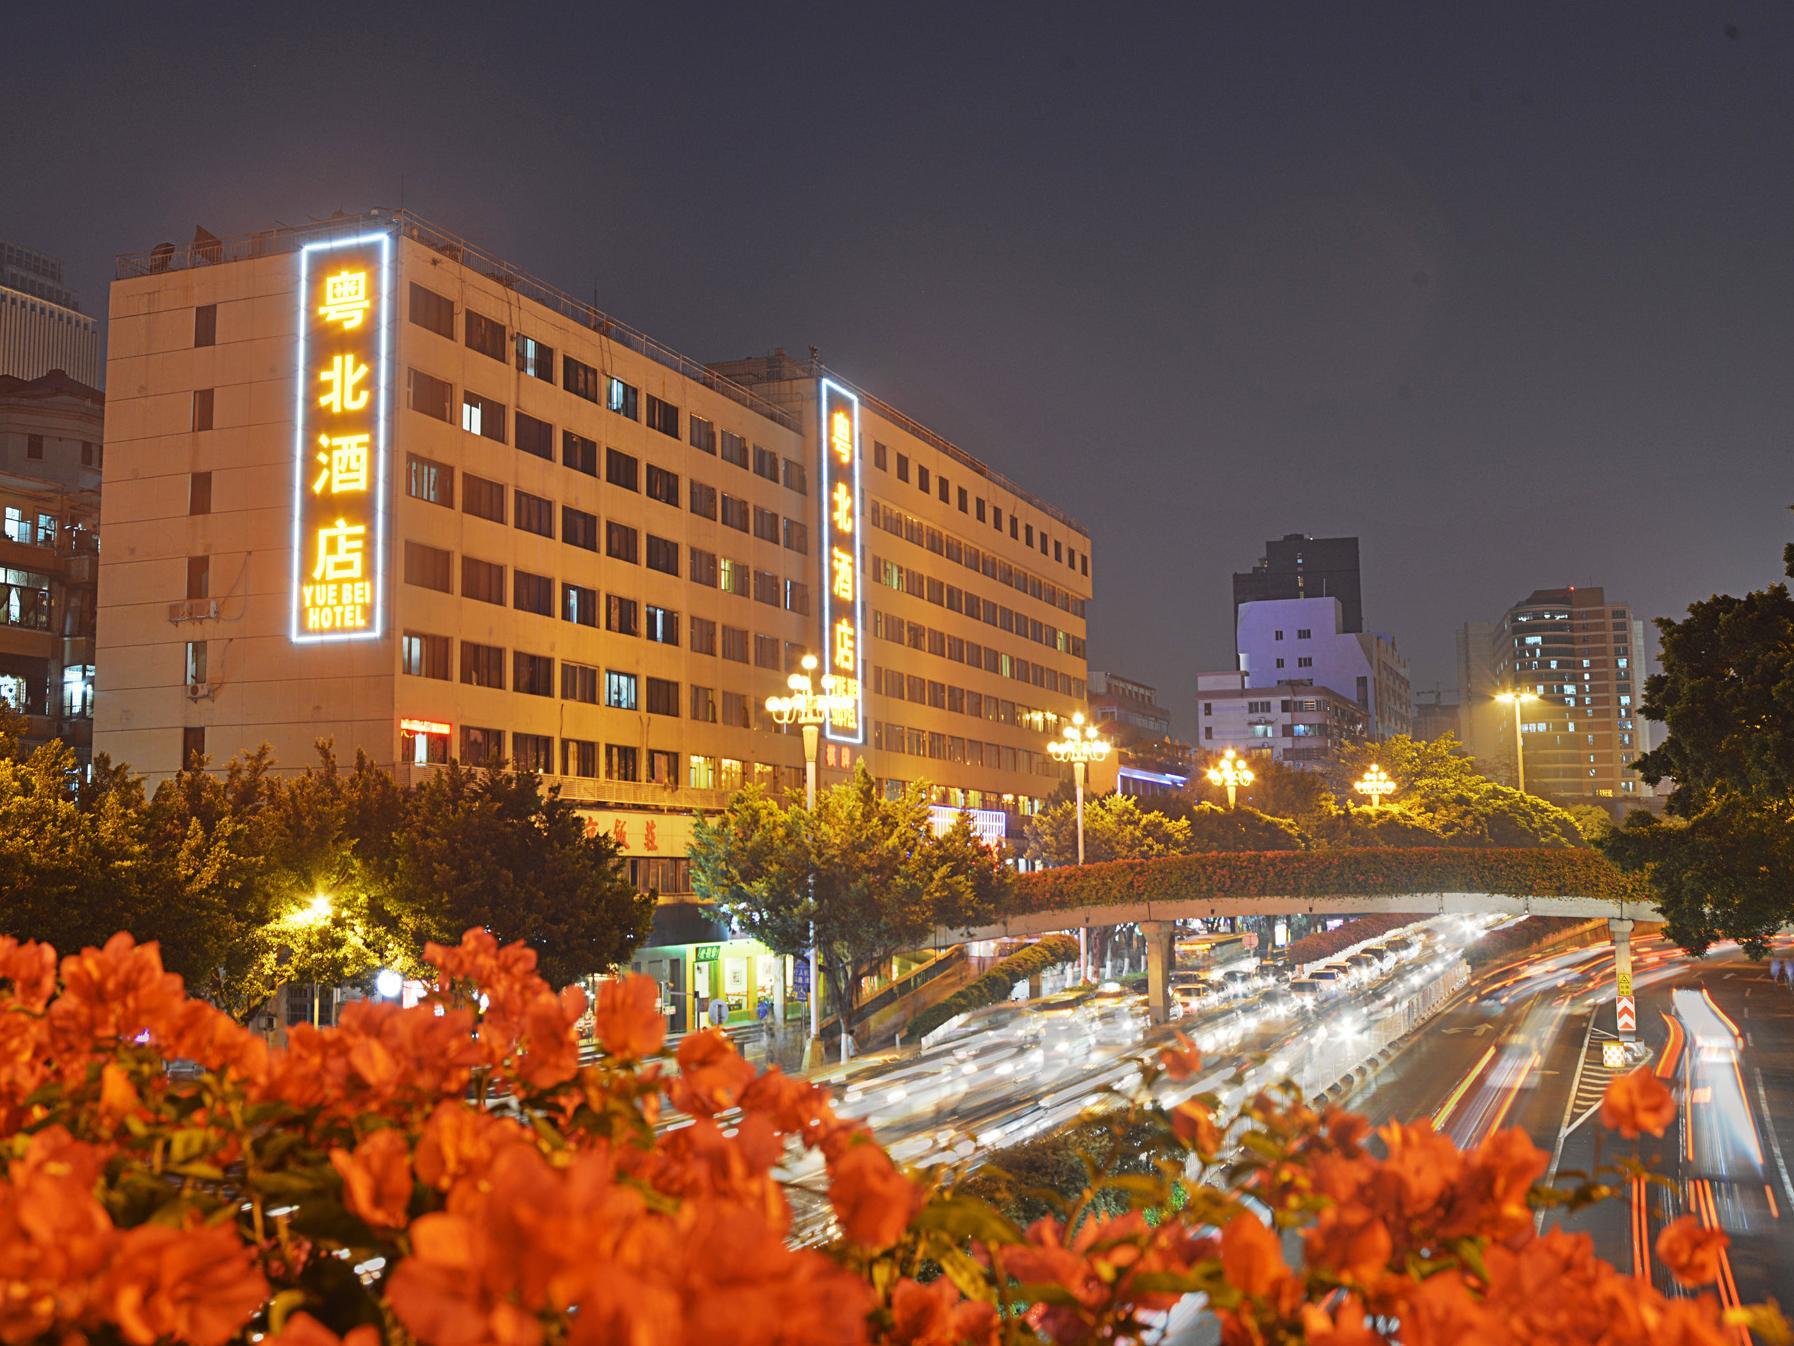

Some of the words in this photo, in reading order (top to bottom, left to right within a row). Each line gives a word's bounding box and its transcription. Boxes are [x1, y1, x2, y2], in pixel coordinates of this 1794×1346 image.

[312, 271, 370, 581] 粤北酒店
[303, 584, 337, 607] YUE
[341, 582, 370, 605] BEI
[831, 412, 853, 672] 粤北酒店
[308, 605, 365, 629] HOTEL
